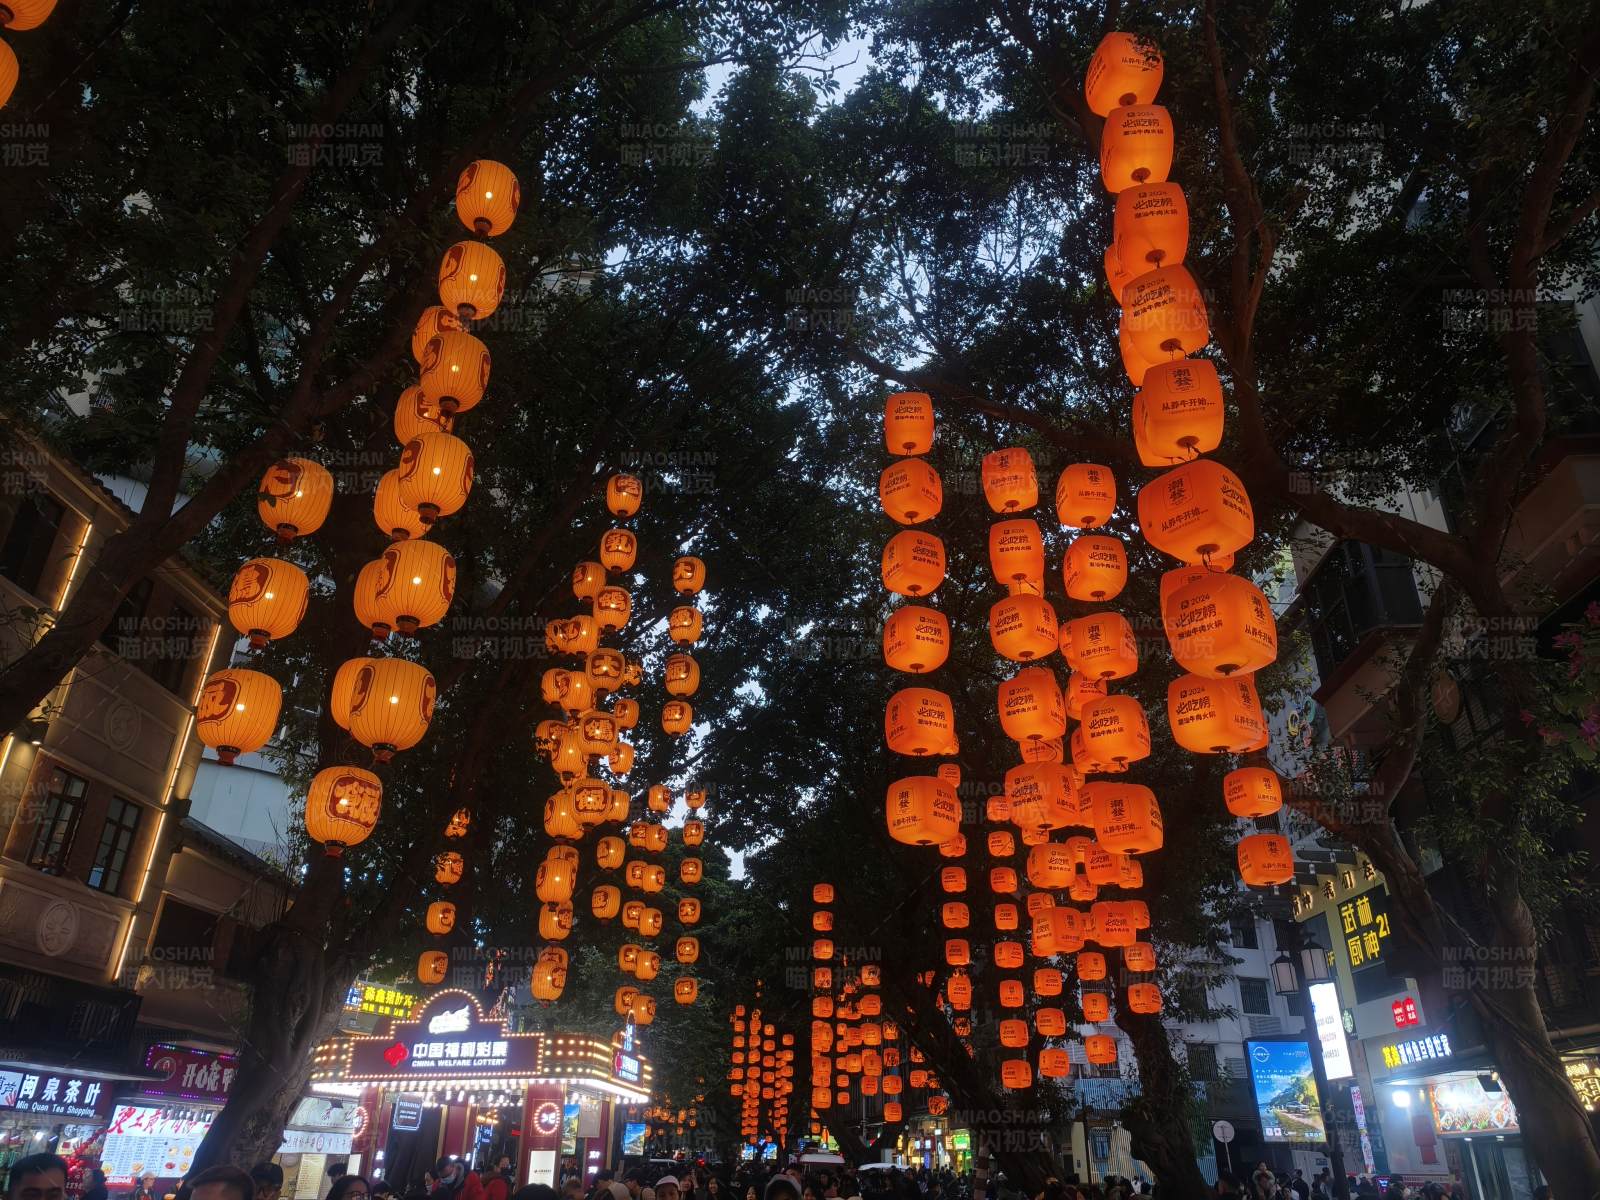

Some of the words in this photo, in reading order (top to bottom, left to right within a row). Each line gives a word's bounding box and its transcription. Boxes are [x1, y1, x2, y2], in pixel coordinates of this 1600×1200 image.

[1132, 198, 1173, 209] 必吃榜
[1132, 285, 1172, 307] 必吃榜
[998, 535, 1029, 545] 必吃榜
[1191, 592, 1211, 606] 2024
[994, 612, 1021, 629] 必吃榜
[1176, 603, 1218, 629] 必吃榜
[1177, 619, 1224, 641] 潮汕牛肉火锅
[1015, 686, 1031, 696] 2024
[1189, 686, 1206, 697] 2024
[1004, 694, 1034, 708] 必吃榜
[1175, 695, 1212, 715] 必吃榜
[916, 706, 947, 721] 必吃榜
[1006, 704, 1038, 717] 潮汕牛肉火锅
[1100, 707, 1116, 716] 2024
[1088, 715, 1120, 730] 必吃榜
[1177, 711, 1217, 727] 潮汕牛肉火锅
[1090, 726, 1125, 739] 潮汕牛肉火锅
[1341, 895, 1374, 935] 武林
[1347, 930, 1381, 968] 厨神
[412, 1041, 509, 1059] 中国福利彩票
[411, 1060, 436, 1068] CHINA
[437, 1058, 472, 1068] WELFARE
[473, 1058, 507, 1067] LOTTERY
[19, 1074, 101, 1107] 闽泉茶叶
[15, 1100, 30, 1110] Min
[31, 1101, 49, 1113] Quan
[52, 1104, 65, 1113] Tea
[67, 1105, 97, 1118] Shopping
